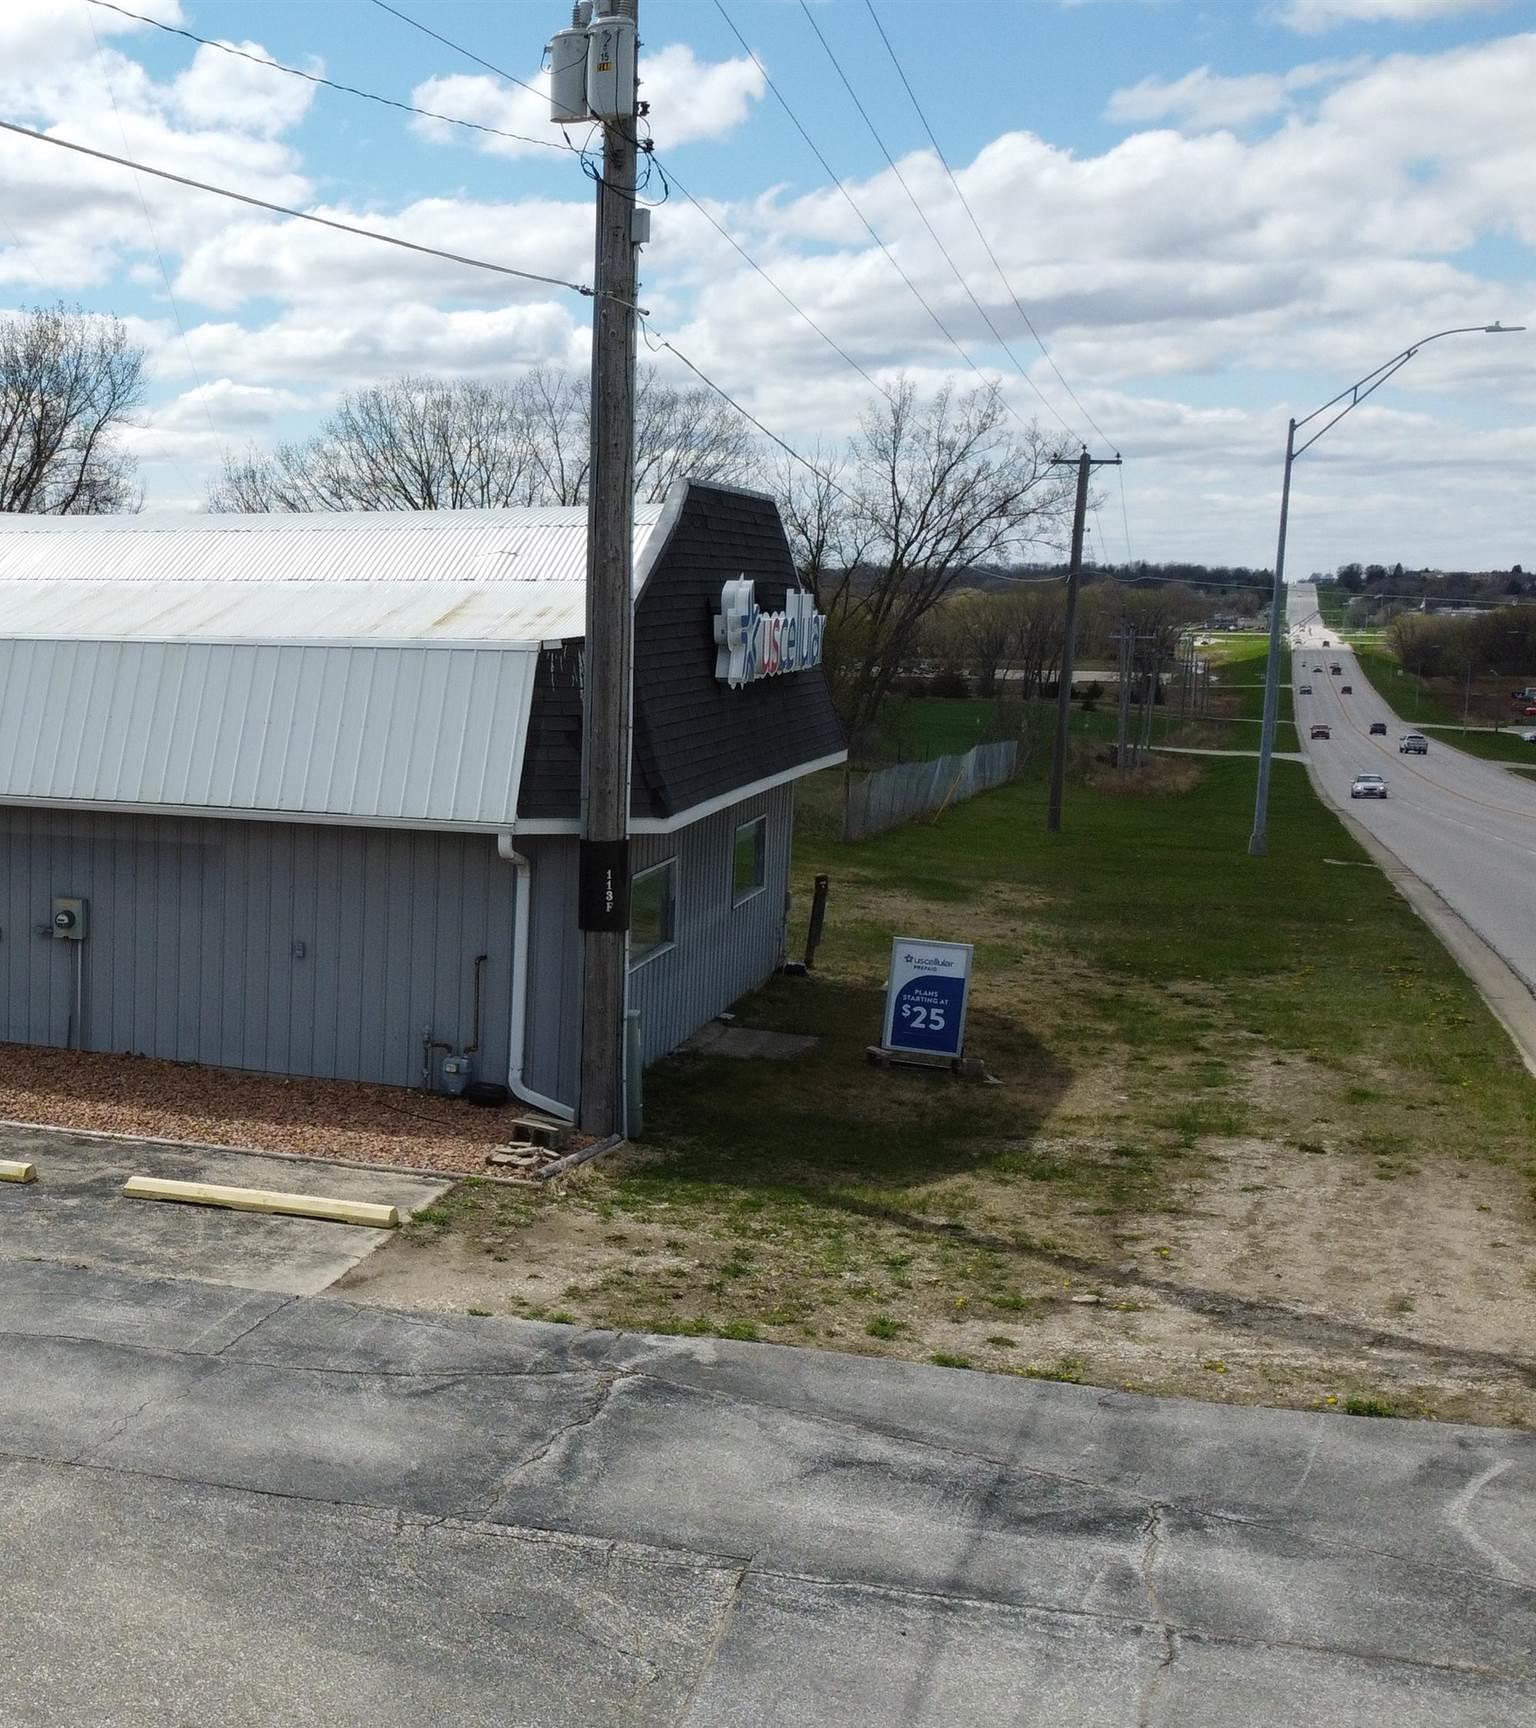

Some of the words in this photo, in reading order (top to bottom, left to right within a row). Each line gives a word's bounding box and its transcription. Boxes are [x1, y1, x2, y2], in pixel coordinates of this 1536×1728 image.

[914, 989, 938, 997] PLANS
[903, 994, 938, 1004] STARTING
[901, 1003, 946, 1031] $25
